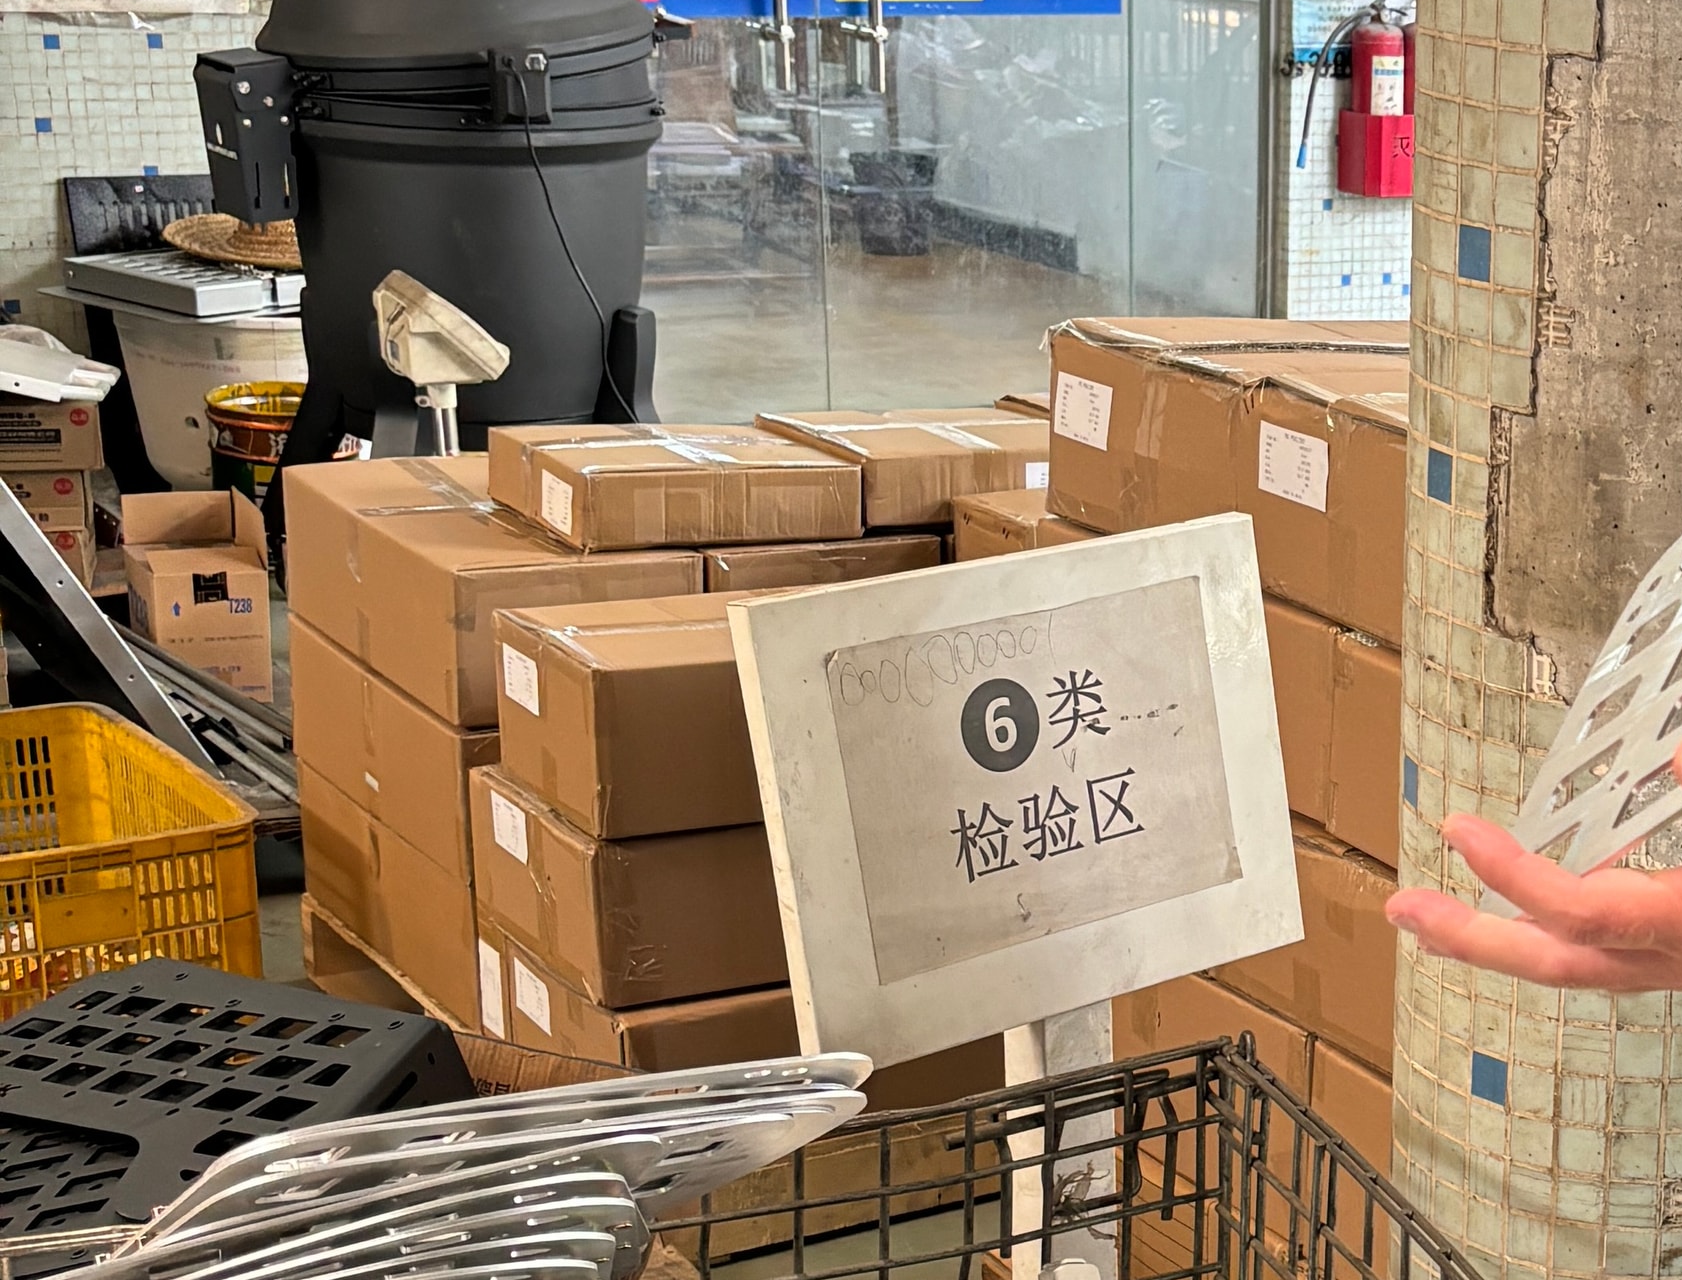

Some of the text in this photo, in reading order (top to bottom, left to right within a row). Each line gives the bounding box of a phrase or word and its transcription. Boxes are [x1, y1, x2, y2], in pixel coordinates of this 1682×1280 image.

[229, 598, 253, 614] T238
[950, 767, 1146, 884] 检验区
